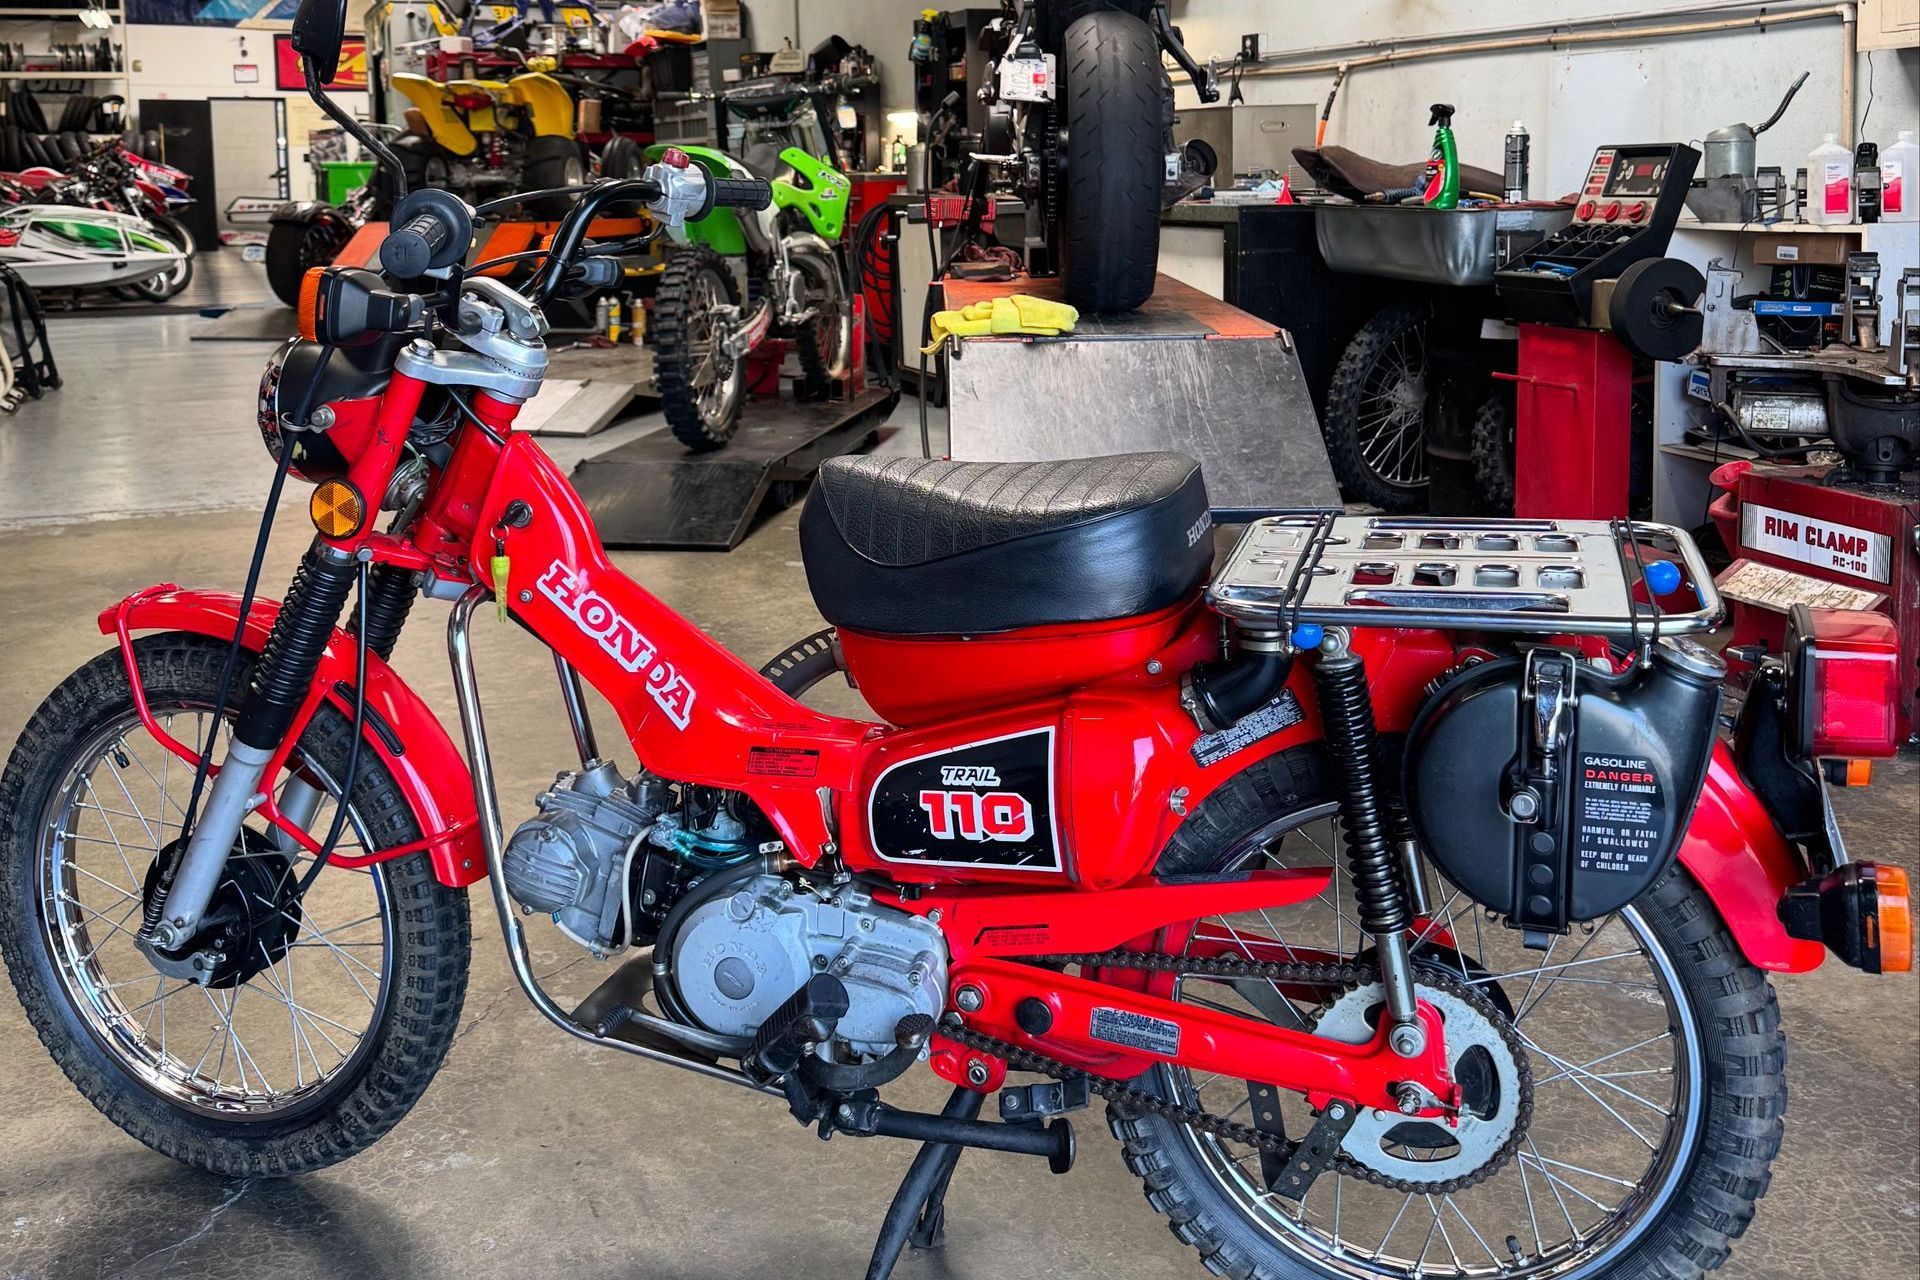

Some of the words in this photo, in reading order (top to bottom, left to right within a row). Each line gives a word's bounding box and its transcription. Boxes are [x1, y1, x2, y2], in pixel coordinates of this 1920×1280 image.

[1764, 515, 1799, 542] RIM
[1805, 525, 1868, 558] CLAMP
[1832, 555, 1868, 573] RC-100
[536, 558, 697, 732] HONDA
[1584, 756, 1647, 770] GASOLINE
[940, 765, 1002, 787] TRAIL
[1585, 769, 1654, 783] DANGER
[1584, 781, 1619, 791] EXTREMELY
[1620, 783, 1657, 794] FLAMMABLE
[919, 789, 1035, 842] 110
[1582, 825, 1615, 836] HARMFUL
[1621, 829, 1630, 837] OR
[1635, 830, 1657, 839] FATAL
[1581, 835, 1590, 843] IF
[1597, 837, 1649, 848] SWALLOWED
[1581, 850, 1597, 859] KEEP
[1600, 851, 1613, 860] OUT
[1616, 853, 1624, 861] OF
[1627, 854, 1648, 863] REACH
[1580, 860, 1589, 868] OF
[1596, 861, 1630, 872] CHILDREN
